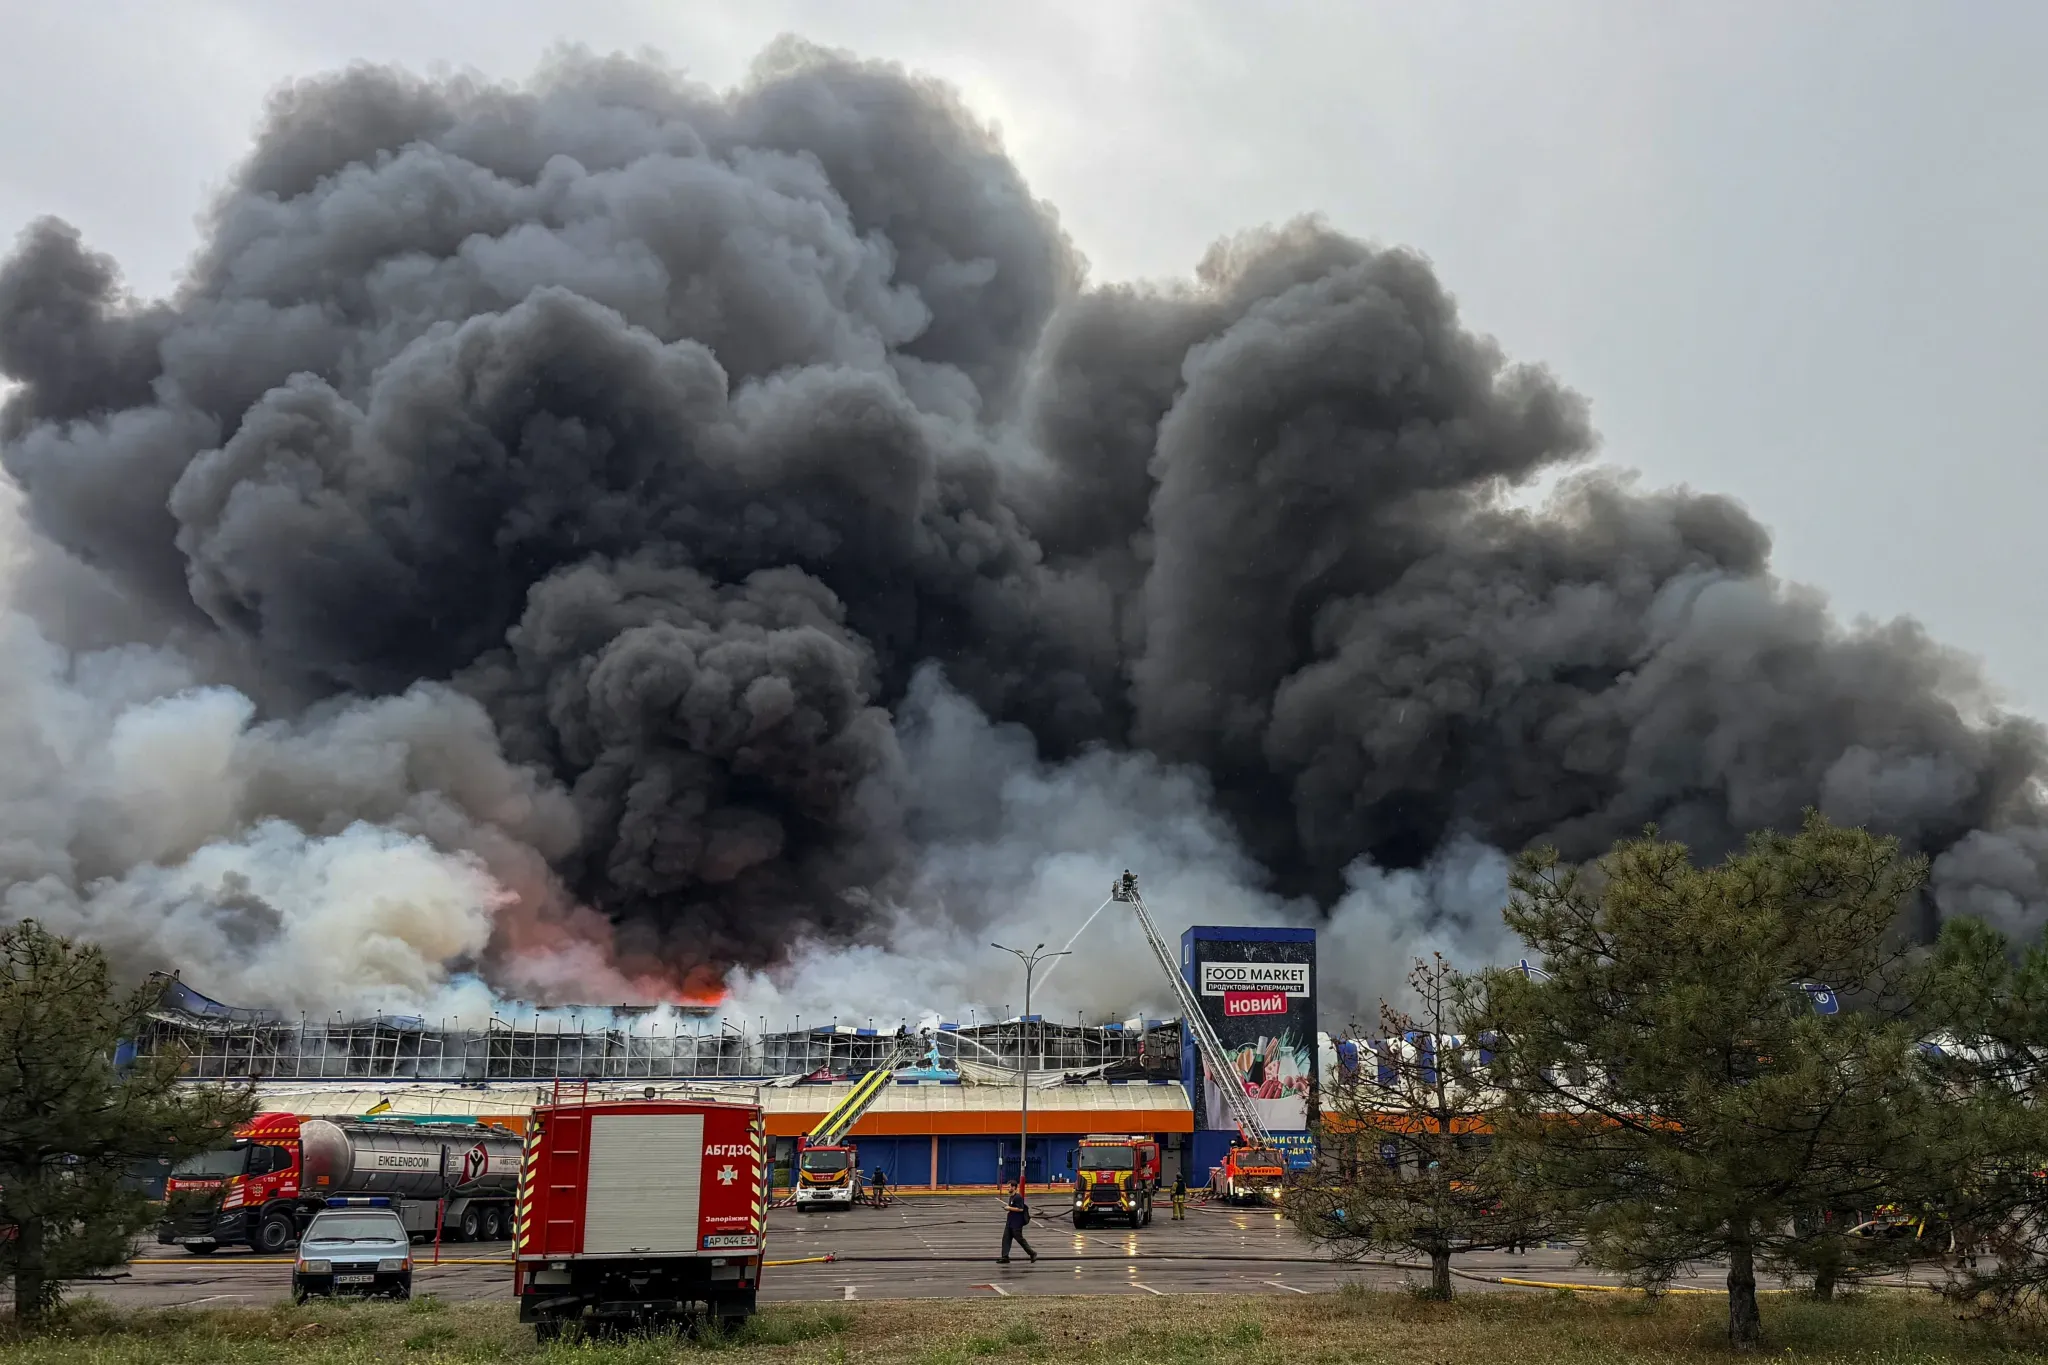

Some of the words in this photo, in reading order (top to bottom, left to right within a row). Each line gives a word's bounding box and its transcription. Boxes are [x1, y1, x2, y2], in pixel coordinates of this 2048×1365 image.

[1206, 968, 1246, 980] FOOD
[1250, 969, 1304, 981] MARKET
[1208, 983, 1255, 991] ПРОДУКТОВИЙ
[1256, 984, 1301, 992] СУПЕРМАРКЕТ
[1229, 995, 1282, 1013] НОВИЙ
[705, 1144, 751, 1157] АБГДЗС
[378, 1155, 429, 1167] EIKELENBOOM
[709, 1237, 722, 1245] AP
[724, 1237, 739, 1245] 044
[741, 1236, 747, 1245] E
